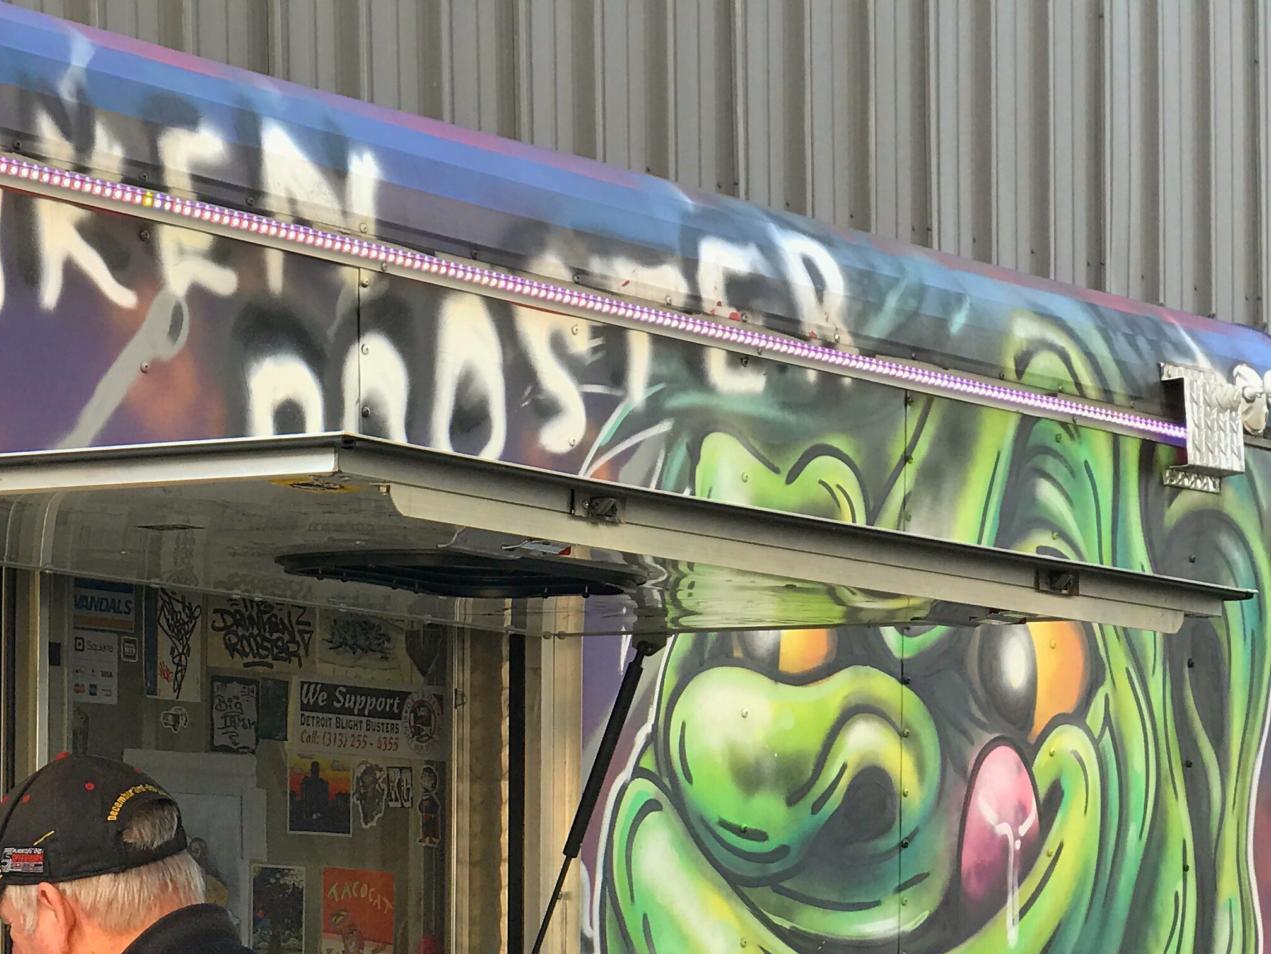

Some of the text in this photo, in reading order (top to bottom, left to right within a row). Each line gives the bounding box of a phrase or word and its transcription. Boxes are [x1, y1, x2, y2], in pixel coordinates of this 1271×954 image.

[74, 592, 133, 615] VANDALS
[301, 682, 401, 716] We Support
[300, 713, 400, 735] DETROIT BLIGHT BUSTERS
